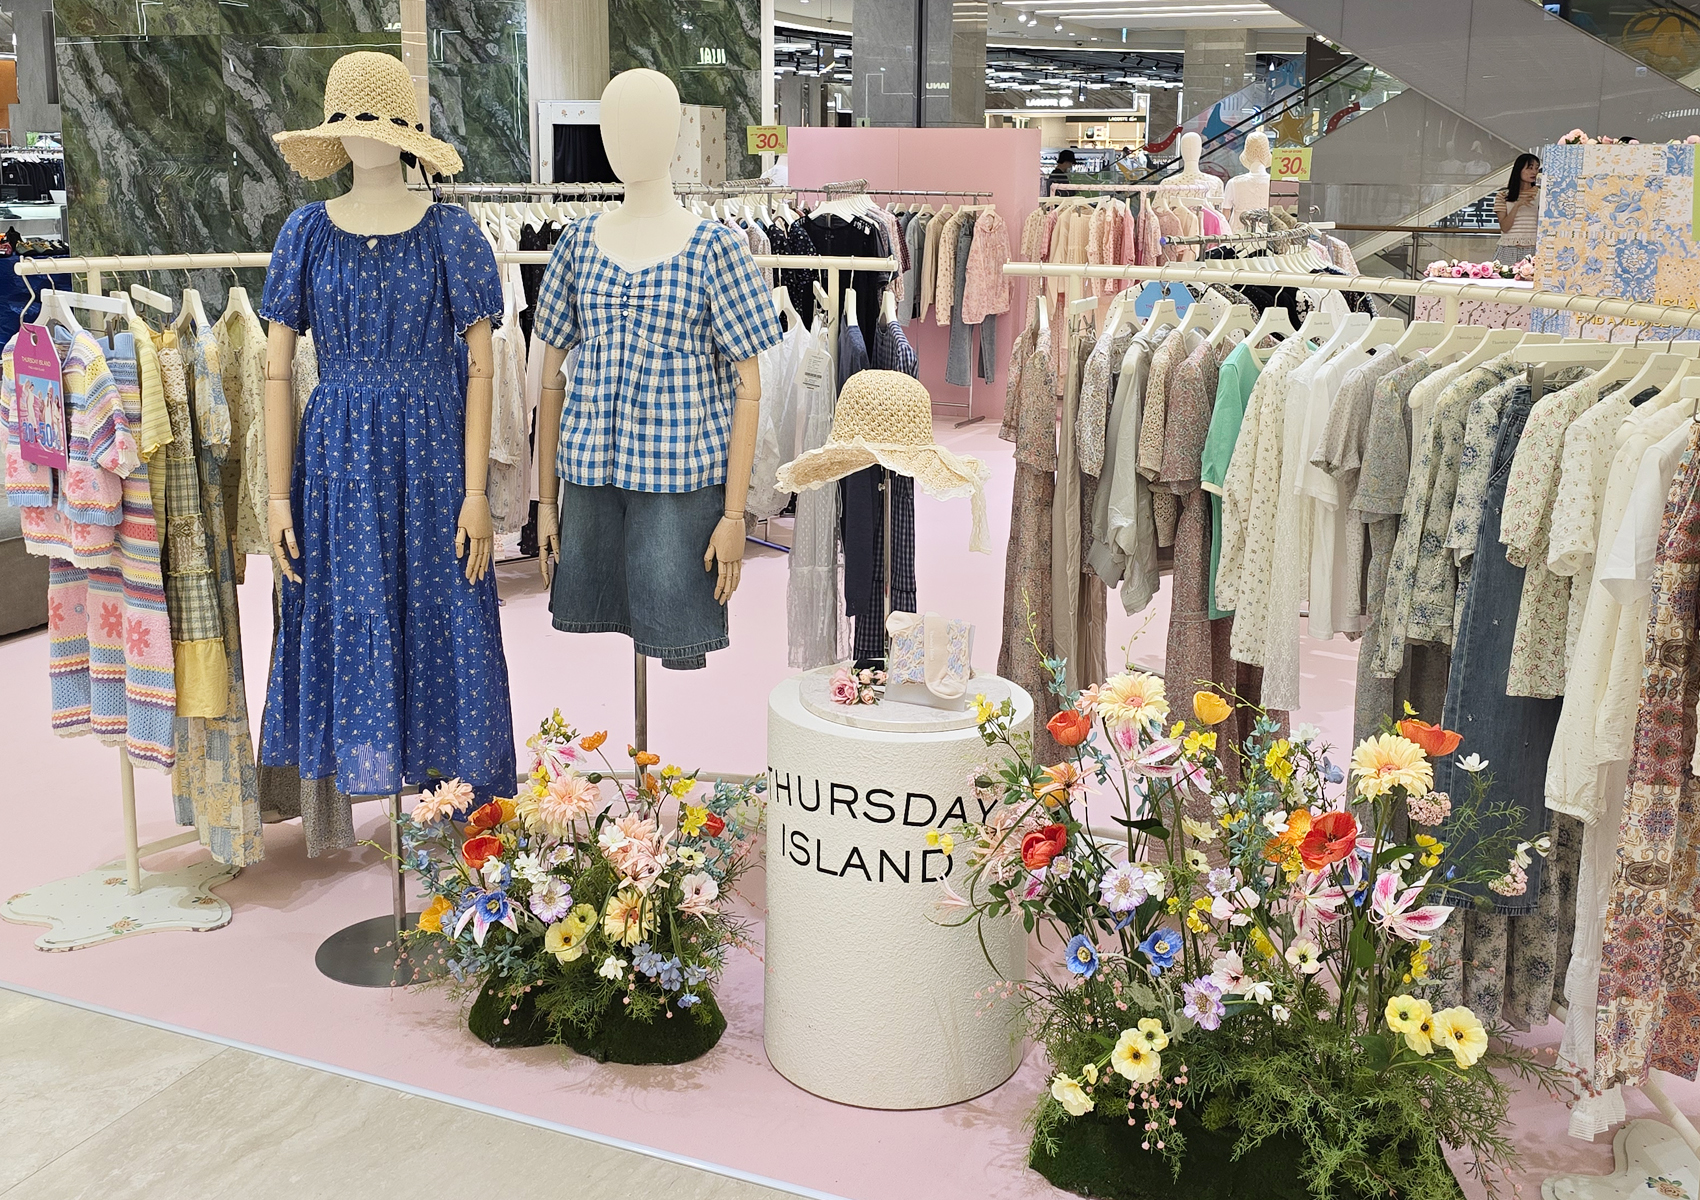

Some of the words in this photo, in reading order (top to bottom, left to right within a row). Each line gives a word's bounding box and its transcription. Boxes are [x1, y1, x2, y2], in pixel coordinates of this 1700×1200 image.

[755, 133, 785, 149] 30%
[1278, 156, 1307, 175] 30%
[782, 823, 953, 884] ISLAND
